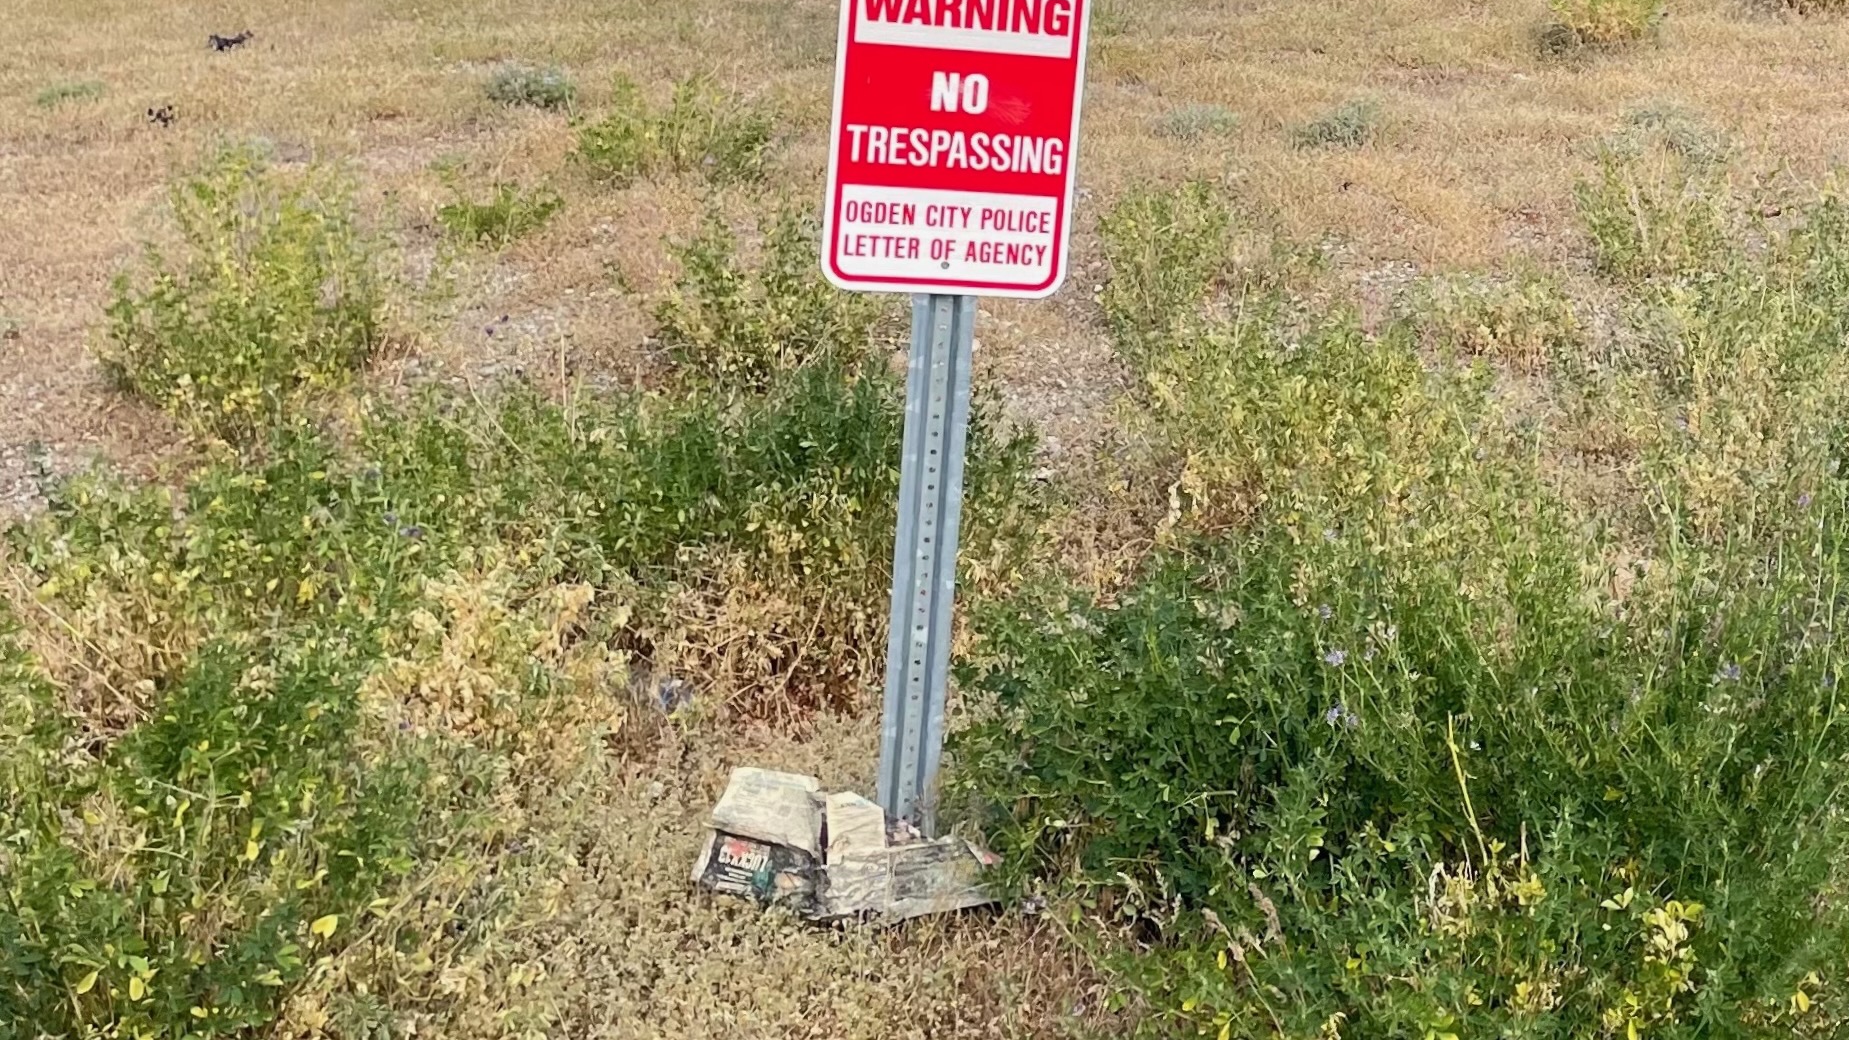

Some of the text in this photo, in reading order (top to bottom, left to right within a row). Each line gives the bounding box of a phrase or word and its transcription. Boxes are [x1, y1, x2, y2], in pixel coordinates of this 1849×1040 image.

[930, 71, 989, 115] NO
[846, 124, 1063, 175] TRESPASSING
[845, 200, 1051, 235] OGDEN CITY POLICE
[843, 233, 1048, 267] LETTER OF AGENCY
